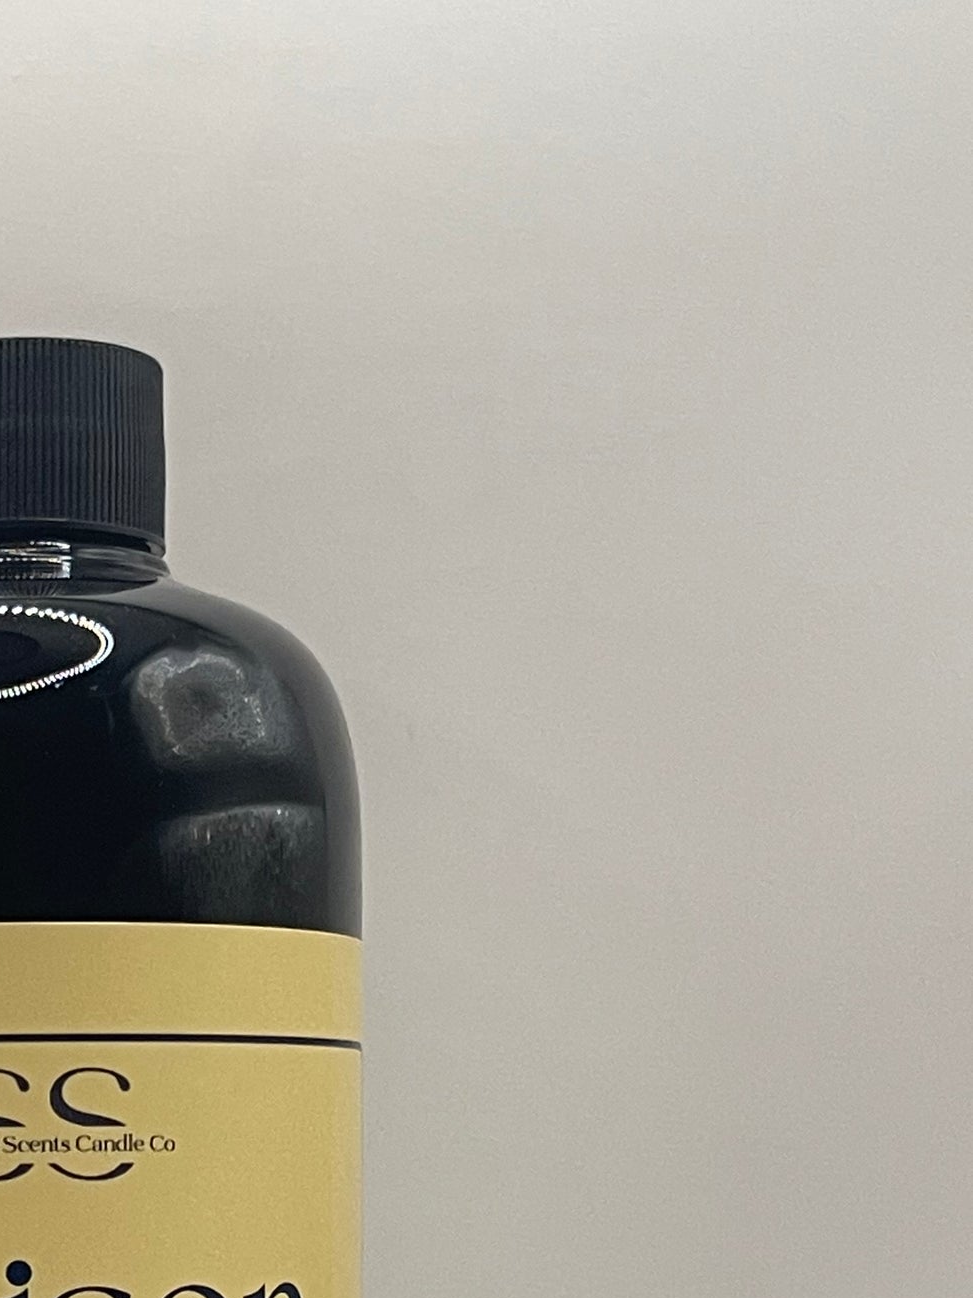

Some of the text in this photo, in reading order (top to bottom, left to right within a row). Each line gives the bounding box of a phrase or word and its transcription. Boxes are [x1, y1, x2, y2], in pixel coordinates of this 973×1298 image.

[3, 1137, 70, 1153] Scents
[76, 1134, 144, 1151] Candle
[150, 1135, 175, 1152] Co
